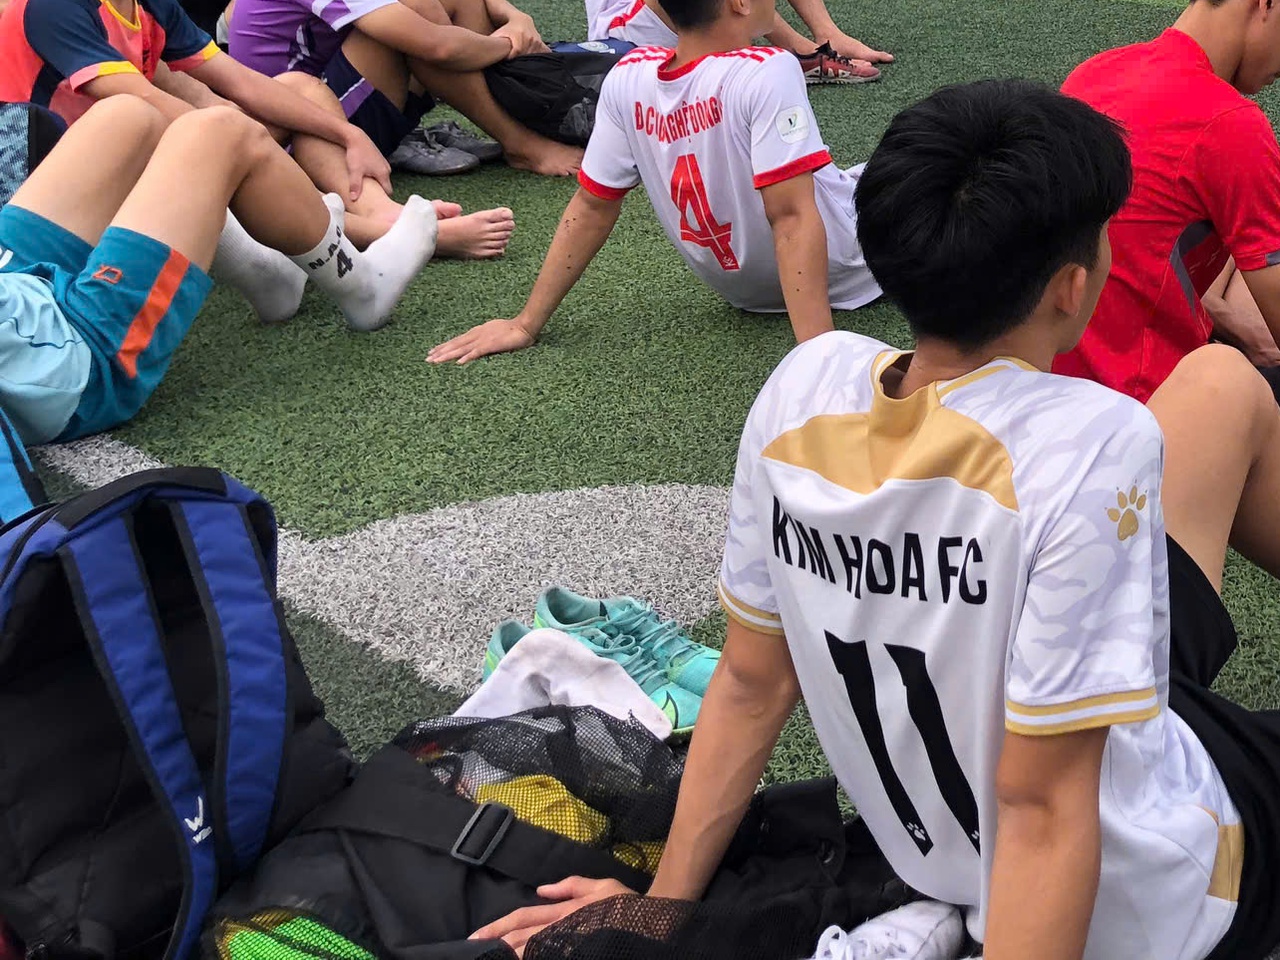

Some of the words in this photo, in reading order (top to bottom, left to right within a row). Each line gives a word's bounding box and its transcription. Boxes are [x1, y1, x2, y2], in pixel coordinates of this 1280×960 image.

[336, 248, 354, 279] 4
[670, 154, 740, 271] 4
[771, 495, 836, 584] KIM
[833, 532, 928, 602] HOA
[939, 536, 988, 605] FC
[824, 629, 981, 858] 11
